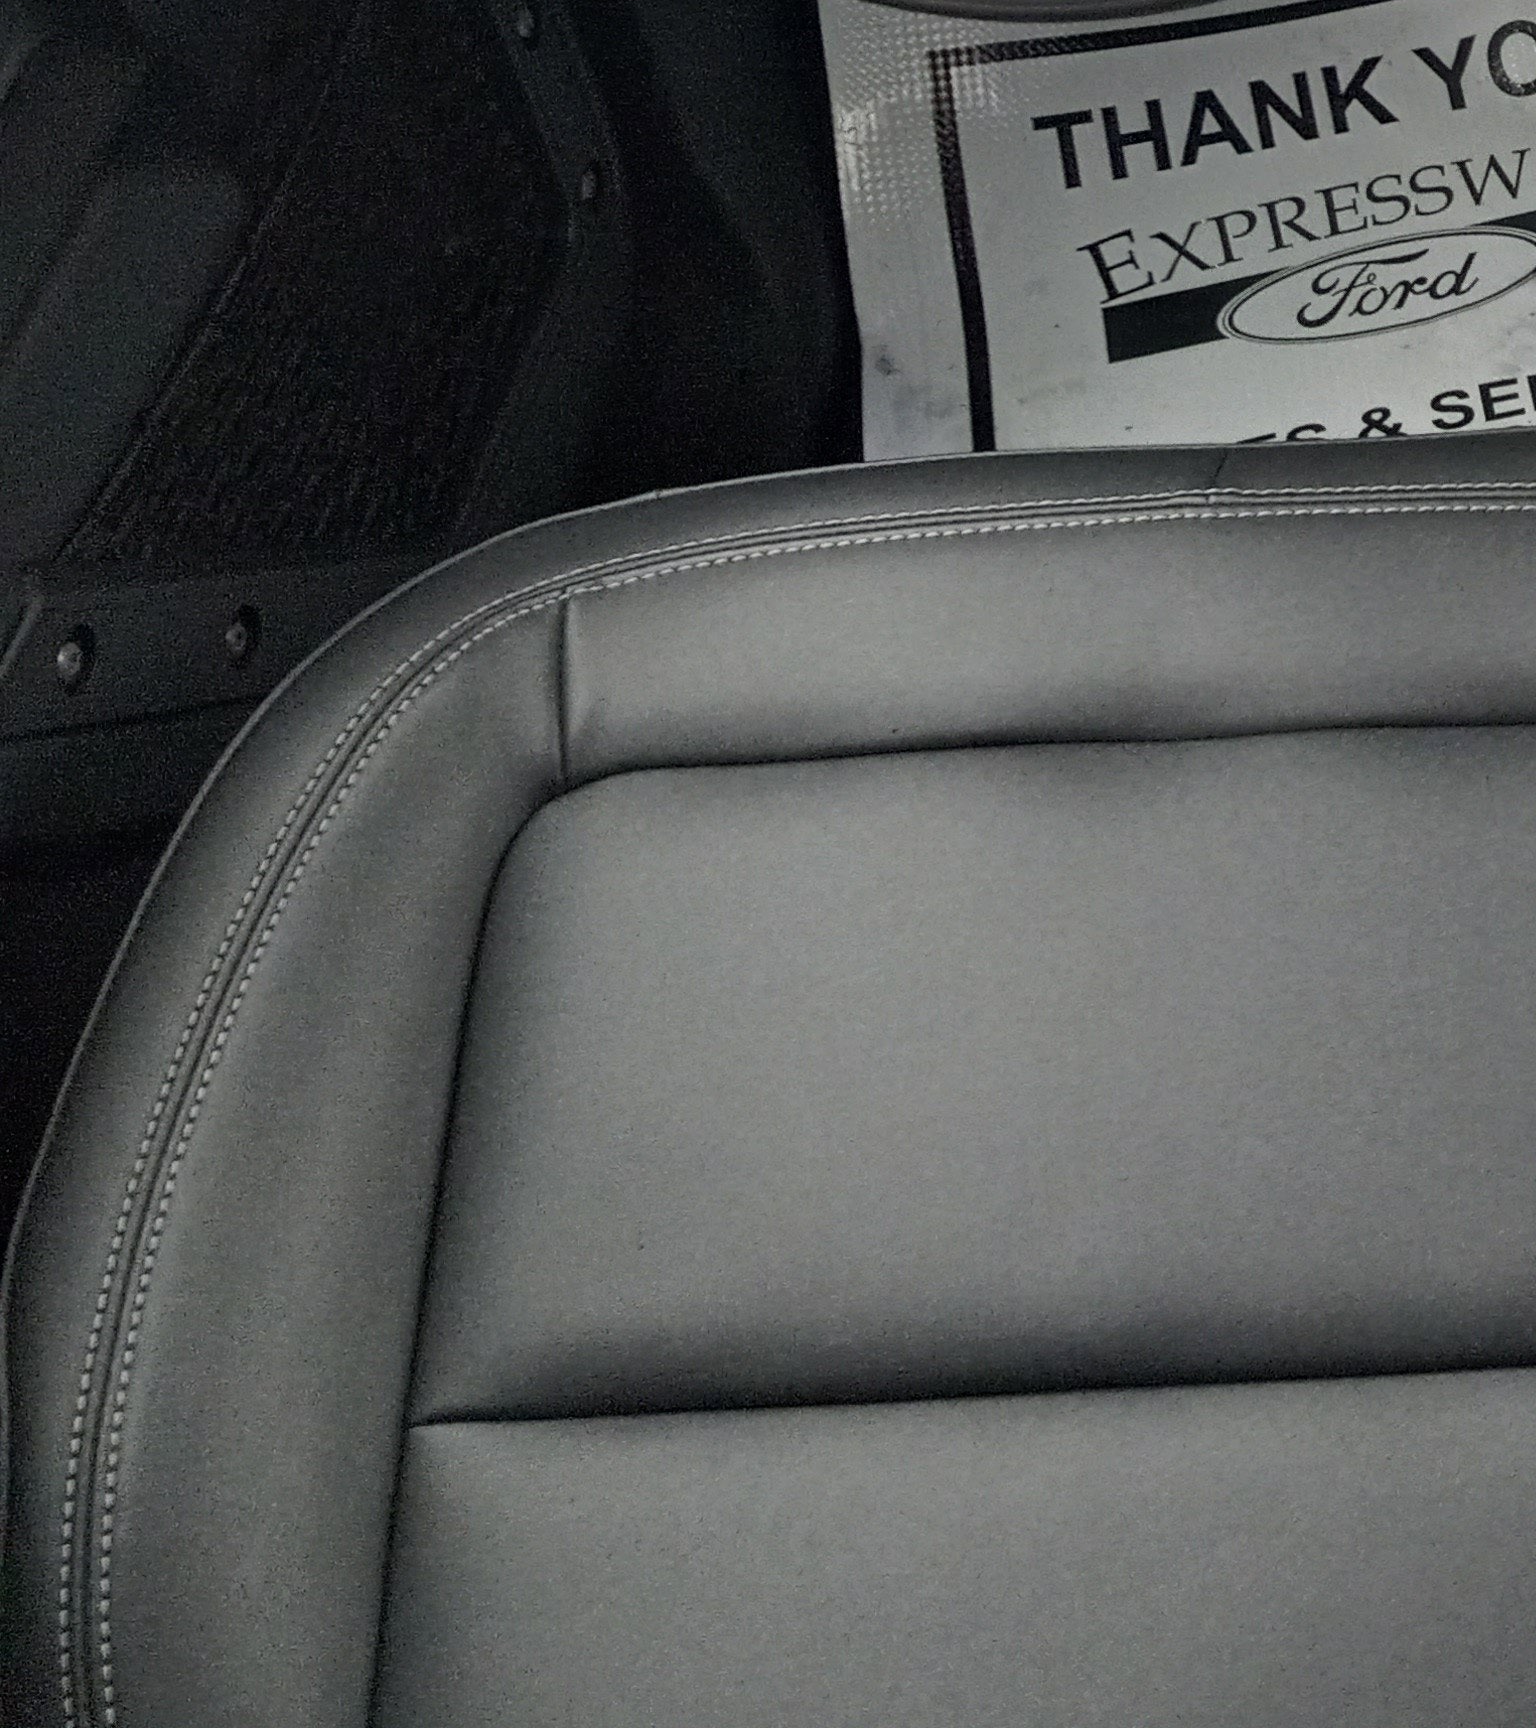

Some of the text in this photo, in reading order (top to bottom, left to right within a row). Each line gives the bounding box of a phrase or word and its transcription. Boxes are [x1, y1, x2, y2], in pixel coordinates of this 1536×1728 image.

[1029, 54, 1400, 190] THANK
[1296, 248, 1480, 328] Ford
[1358, 406, 1409, 438] &
